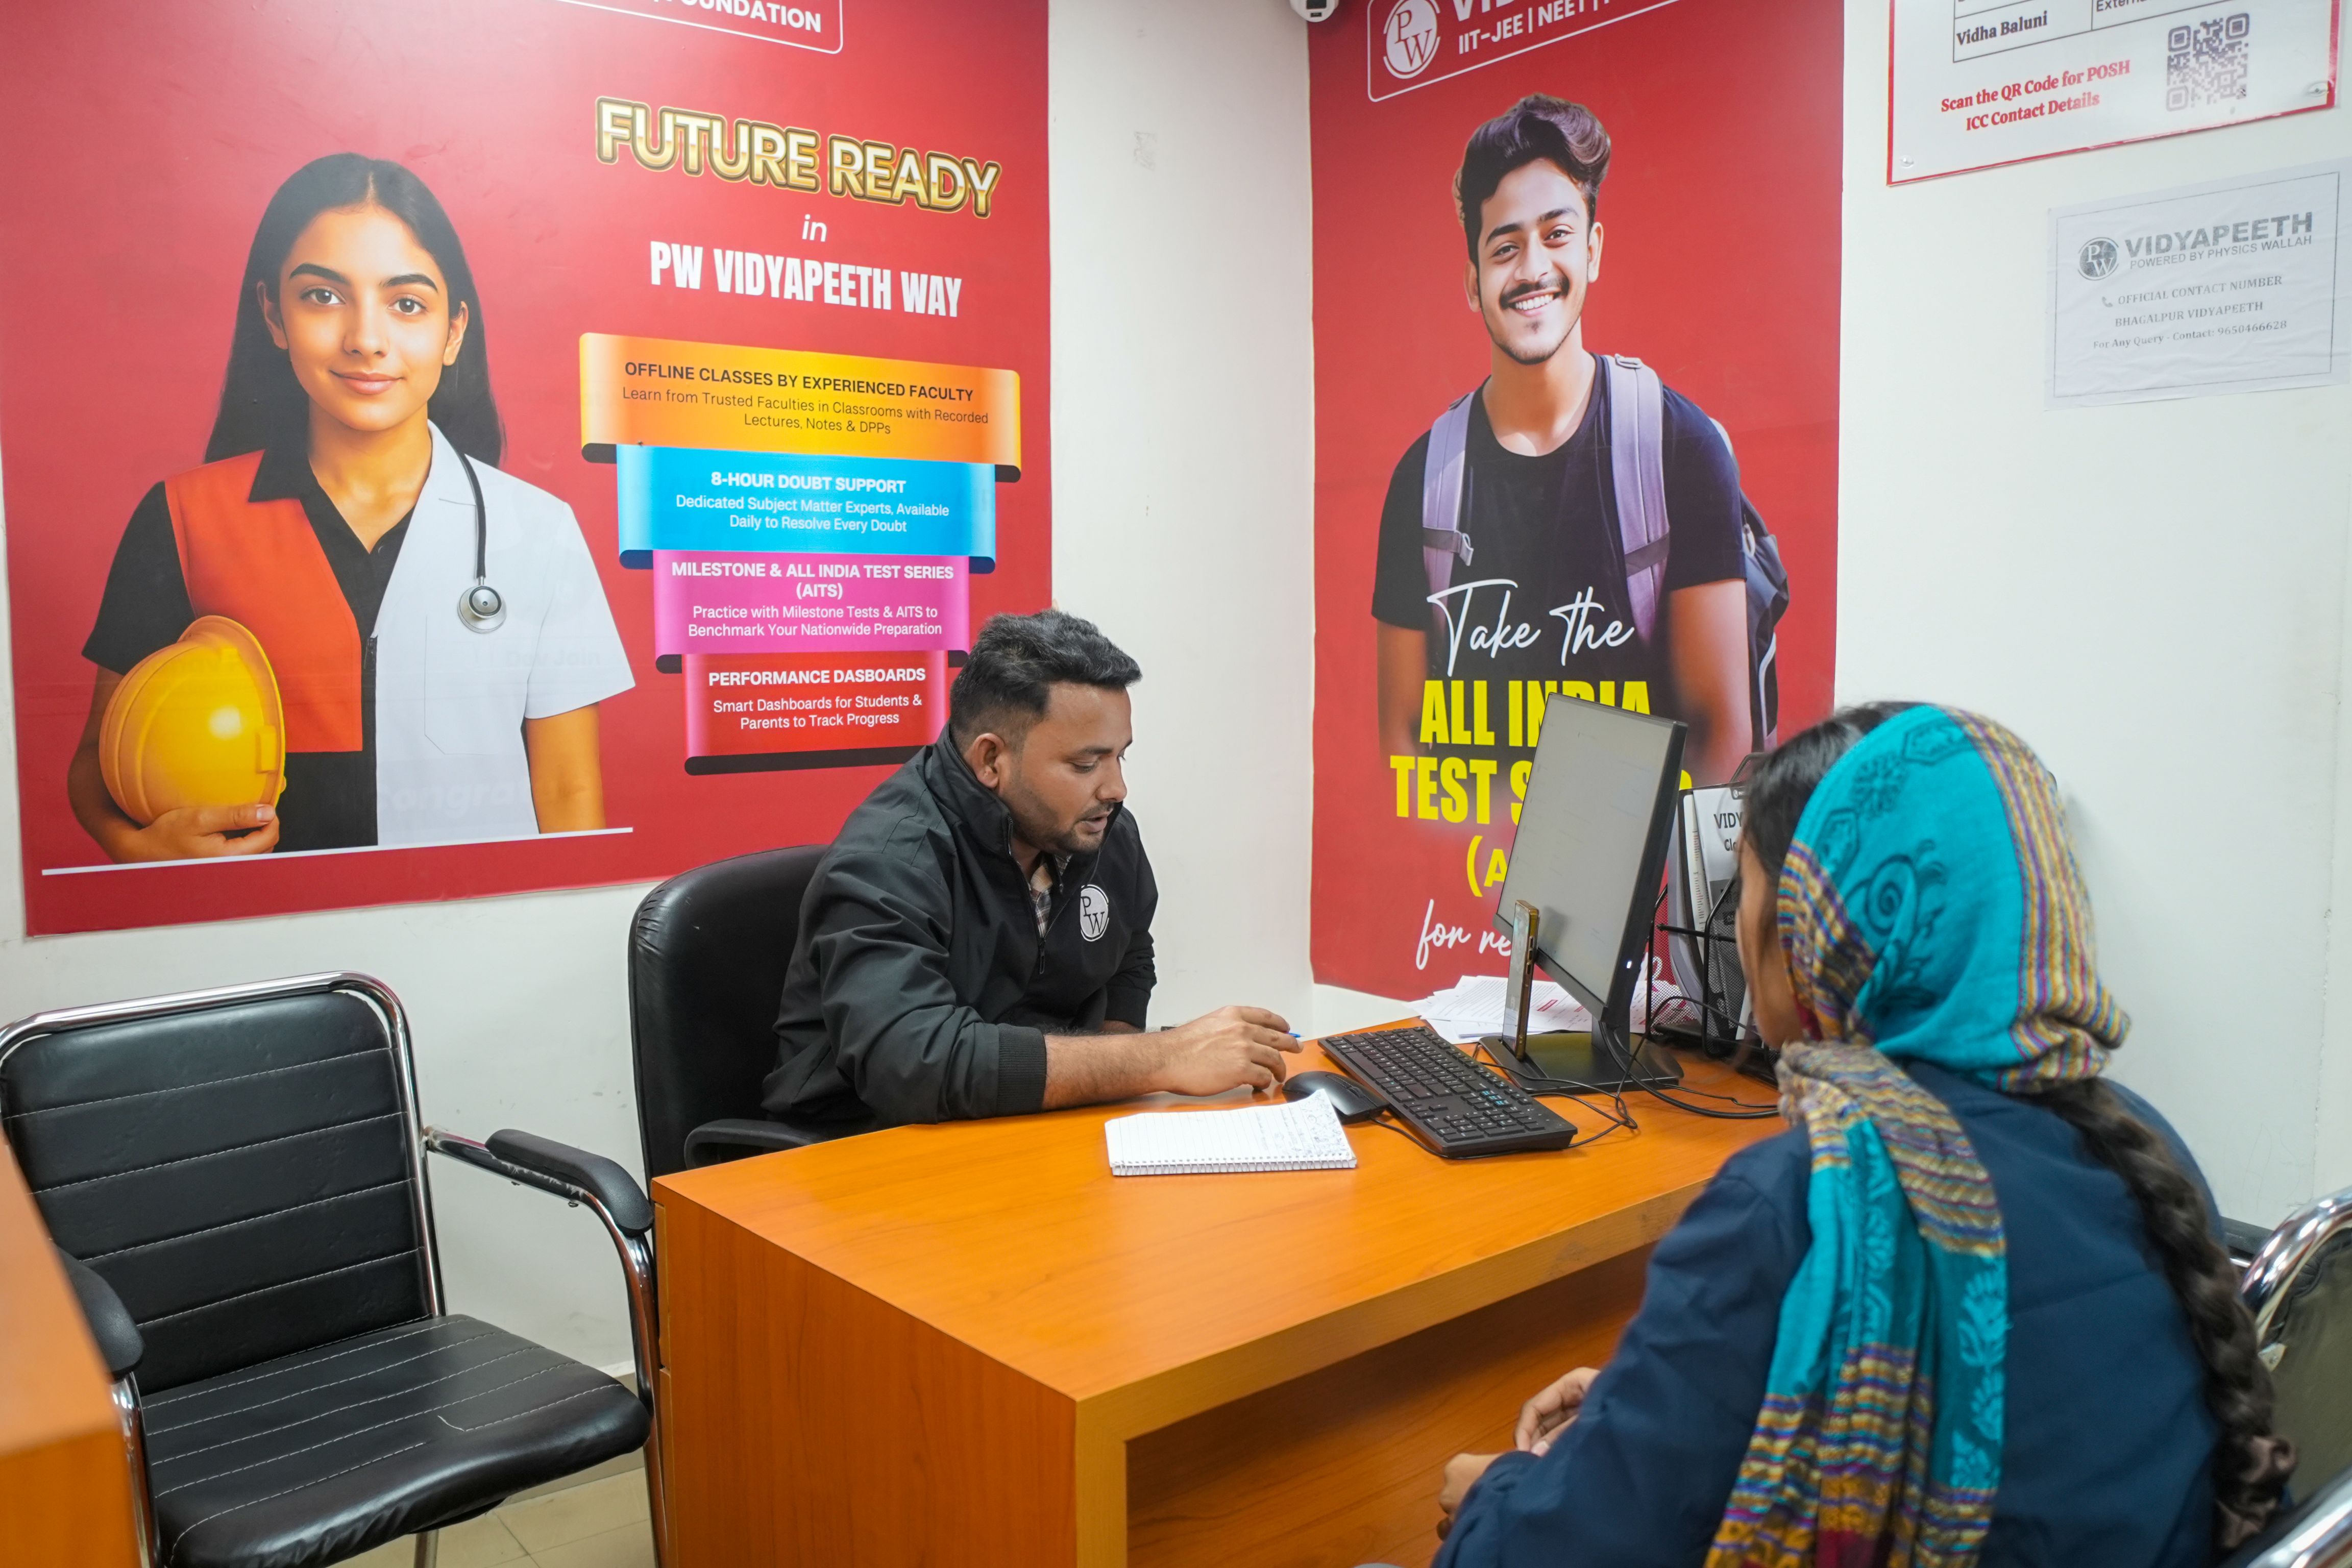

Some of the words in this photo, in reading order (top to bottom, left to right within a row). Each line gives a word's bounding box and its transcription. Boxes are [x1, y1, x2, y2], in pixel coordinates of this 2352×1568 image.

[1459, 14, 1523, 54] IIT-JEE
[1956, 26, 1996, 45] Vidha
[2001, 11, 2047, 35] Baluni
[1942, 96, 1972, 112] Scan
[1976, 89, 1998, 104] the
[2002, 84, 2021, 101] QR
[2025, 75, 2059, 93] Code
[2063, 71, 2084, 86] for
[2088, 60, 2130, 81] POSH
[1967, 114, 1988, 130] ICC
[1992, 103, 2044, 125] Contact
[2048, 92, 2099, 114] Details
[595, 96, 821, 193] FUTURE
[828, 134, 1001, 219] READY
[802, 214, 826, 241] in
[2124, 211, 2312, 258] VIDYAPEETH
[2130, 254, 2186, 270] POWERED
[2190, 251, 2203, 261] BY
[2208, 243, 2257, 258] PHYSICS
[2262, 235, 2311, 250] WALLAH
[651, 241, 703, 289] PW
[714, 249, 891, 310] VIDYAPEETH
[901, 272, 962, 317] WAY
[2119, 291, 2168, 304] OFFICIAL
[2172, 283, 2226, 298] CONTACT
[2231, 276, 2282, 290] NUMBER
[2116, 311, 2184, 326] BHAGALPUR
[2188, 302, 2263, 318] VIDYAPEETH
[2093, 340, 2110, 349] For
[2113, 339, 2131, 348] Any
[2134, 336, 2164, 346] Query
[2173, 329, 2215, 340] Contact:
[625, 362, 694, 379] OFFLINE
[700, 369, 772, 385] CLASSES
[778, 375, 797, 387] BY
[803, 377, 904, 396] EXPERIENCED
[910, 385, 973, 401] FACULTY
[623, 387, 660, 401] Learn
[666, 389, 697, 403] from
[702, 393, 752, 407] Trusted
[758, 397, 814, 411] Faculties
[818, 399, 829, 412] in
[833, 402, 902, 418] Classrooms
[906, 407, 930, 420] with
[935, 410, 988, 423] Recorded
[745, 414, 803, 430] Lectures,
[807, 418, 842, 431] Notes
[847, 421, 855, 431] &
[861, 422, 890, 434] DPPs
[712, 472, 774, 487] 8-HOUR
[778, 475, 832, 490] DOUBT
[836, 478, 906, 493] SUPPORT
[677, 495, 744, 508] Dedicated
[748, 497, 797, 513] Subject
[801, 500, 842, 512] Matter
[846, 501, 893, 516] Experts,
[897, 503, 949, 516] Available
[730, 515, 761, 530] Daily
[766, 517, 779, 529] to
[782, 517, 830, 530] Resolve
[835, 519, 867, 533] Every
[871, 520, 906, 532] Doubt
[673, 562, 765, 576] MILESTONE
[770, 564, 781, 577] &
[787, 564, 815, 577] ALL
[819, 565, 860, 577] INDIA
[864, 565, 900, 578] TEST
[904, 566, 953, 579] SERIES
[797, 583, 843, 599] (AITS)
[694, 606, 747, 618] Practice
[751, 606, 778, 618] with
[783, 606, 843, 618] Milestone
[847, 606, 879, 618] Tests
[884, 606, 892, 618] &
[896, 606, 922, 617] AITS
[926, 607, 937, 617] to
[689, 624, 764, 636] Benchmark
[768, 624, 797, 635] Your
[801, 623, 870, 635] Nationwide
[875, 624, 941, 637] Preparation
[1427, 579, 1540, 676] Take
[1549, 586, 1634, 666] the
[709, 670, 829, 685] PERFORMANCE
[834, 668, 925, 682] DASBOARDS
[714, 700, 753, 713] Smart
[757, 697, 831, 710] Dashboards
[836, 696, 852, 708] for
[855, 695, 909, 707] Students
[913, 694, 922, 705] &
[1420, 680, 1495, 746] ALL
[741, 717, 790, 729] Parents
[793, 717, 805, 727] to
[809, 714, 843, 726] Track
[847, 714, 899, 727] Progress
[1390, 755, 1498, 824] TEST
[1416, 899, 1471, 970] for
